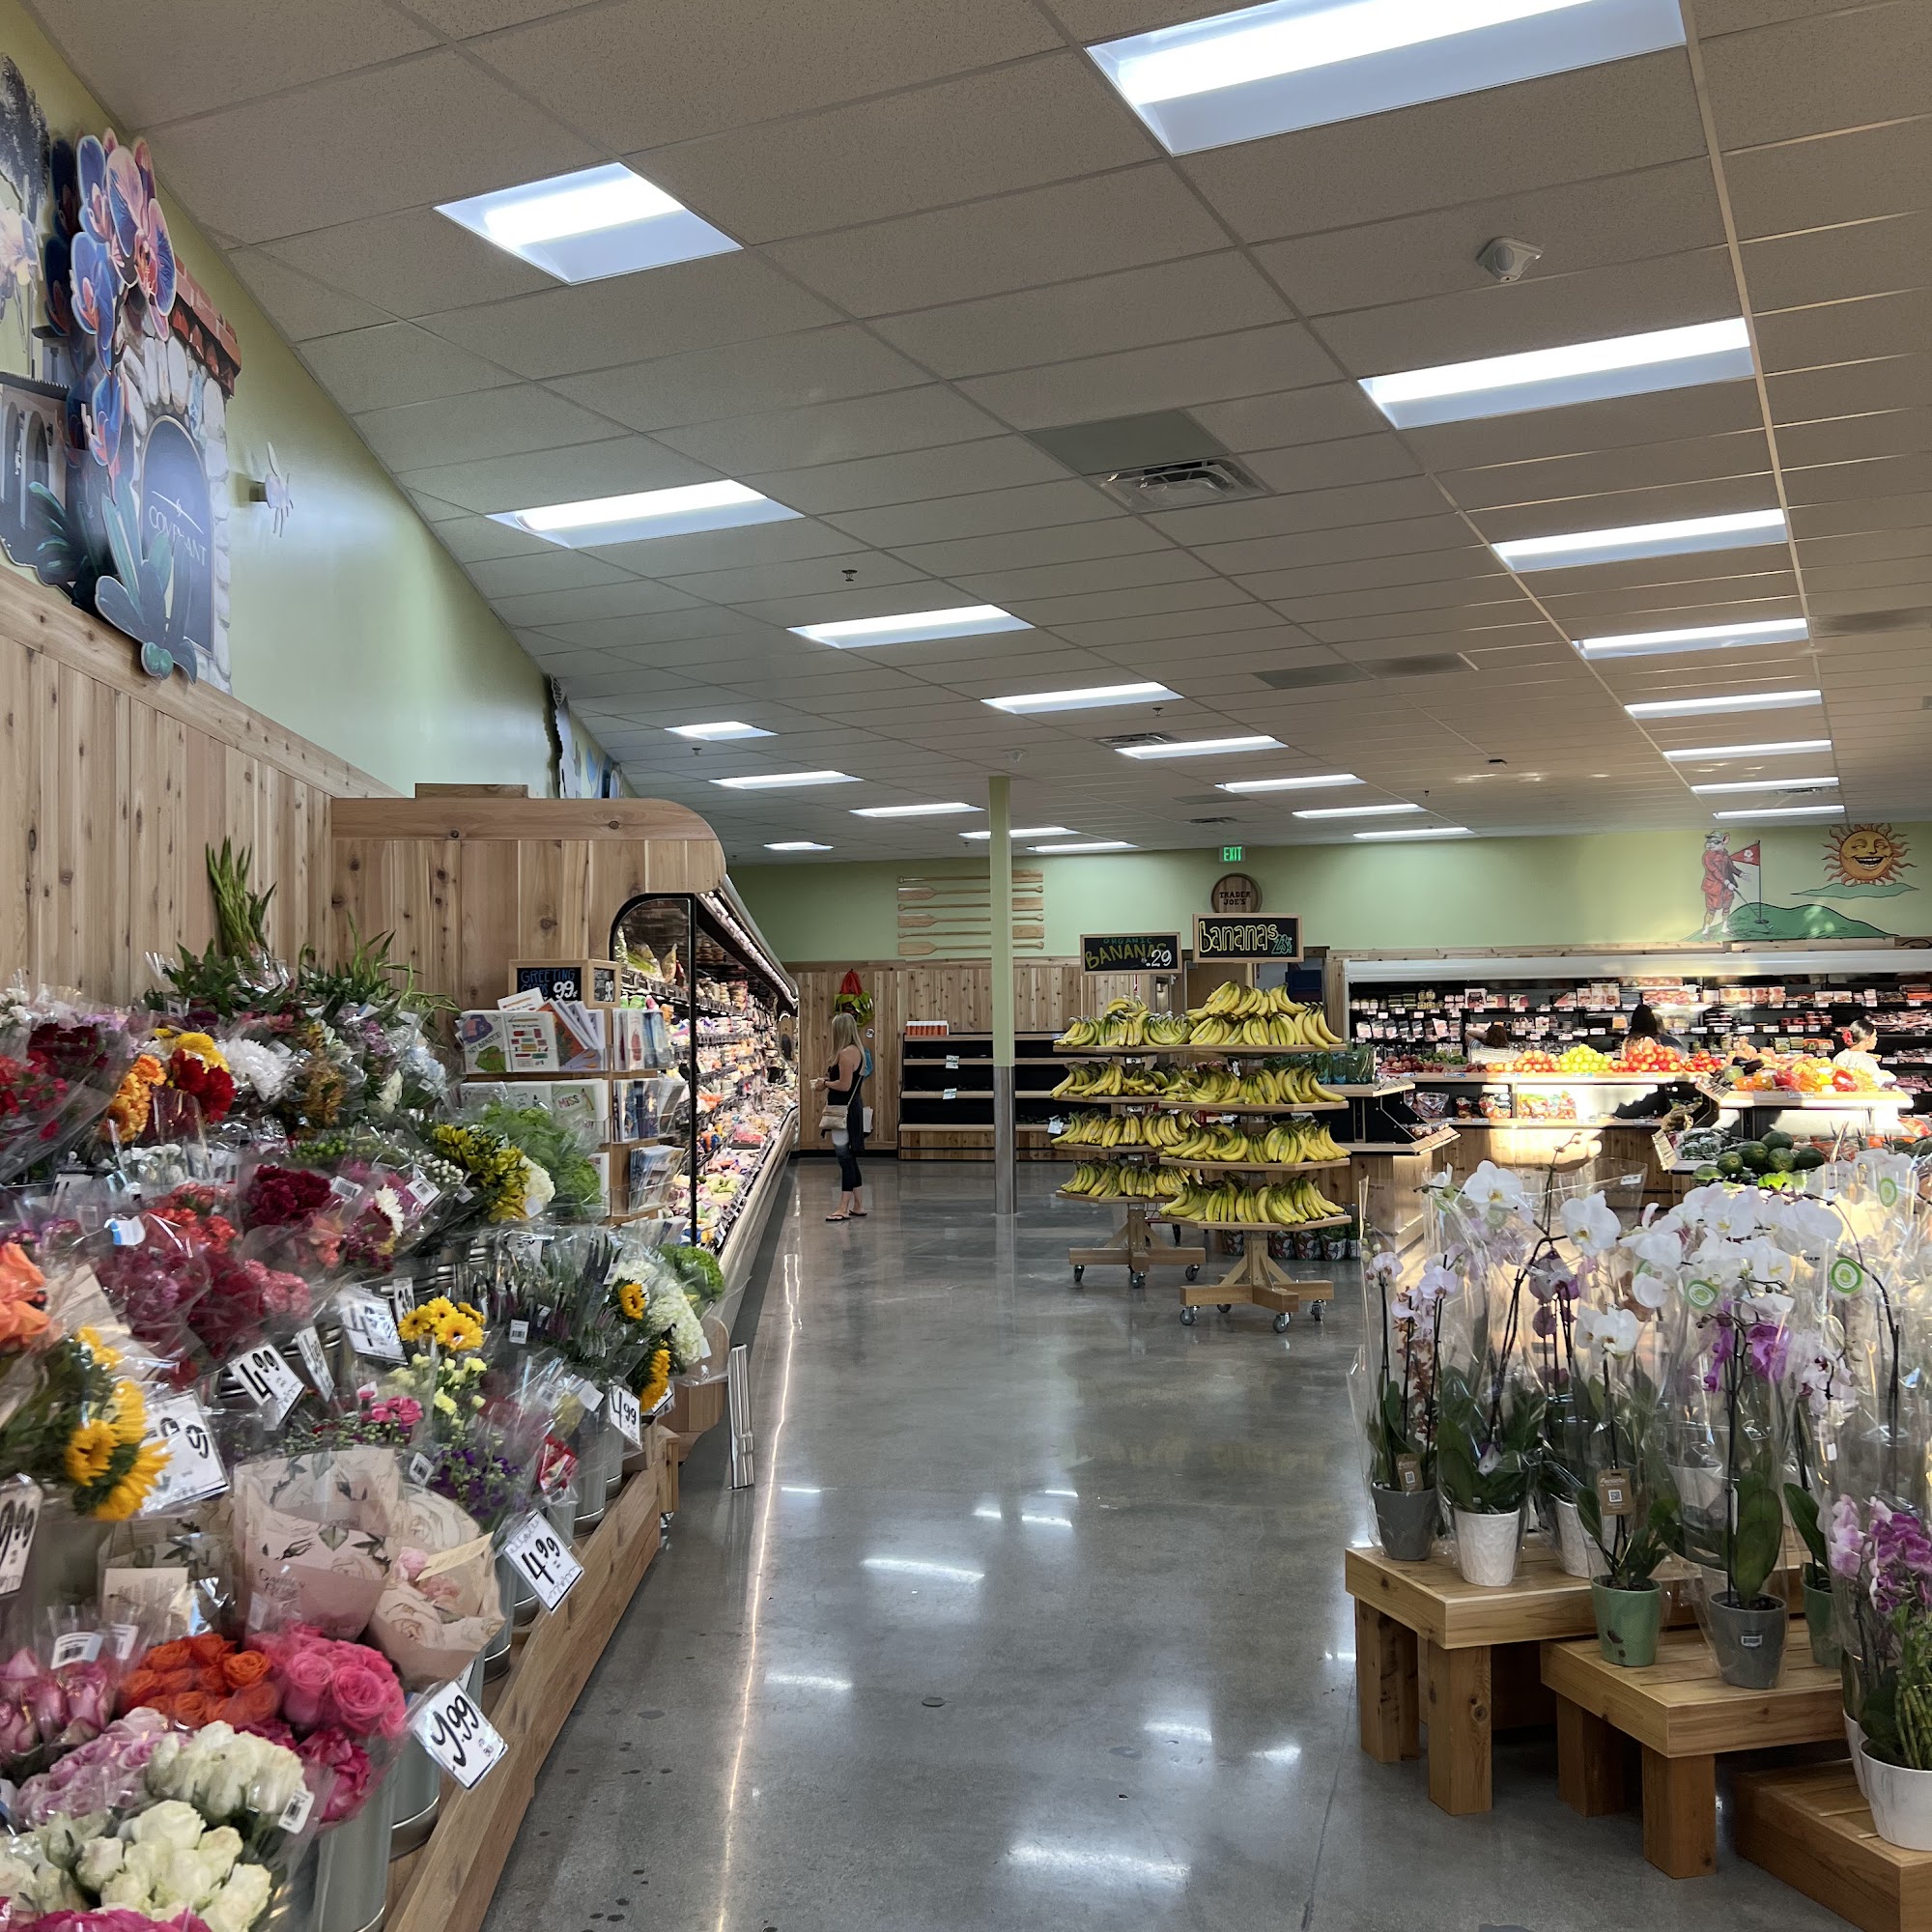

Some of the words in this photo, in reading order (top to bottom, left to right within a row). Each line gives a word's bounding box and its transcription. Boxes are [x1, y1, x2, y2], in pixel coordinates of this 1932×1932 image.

[1223, 846, 1242, 862] EXIT
[1199, 921, 1278, 953] bananas
[1085, 943, 1167, 970] BANANAS
[521, 969, 576, 983] GREETING
[557, 1094, 581, 1109] MISS
